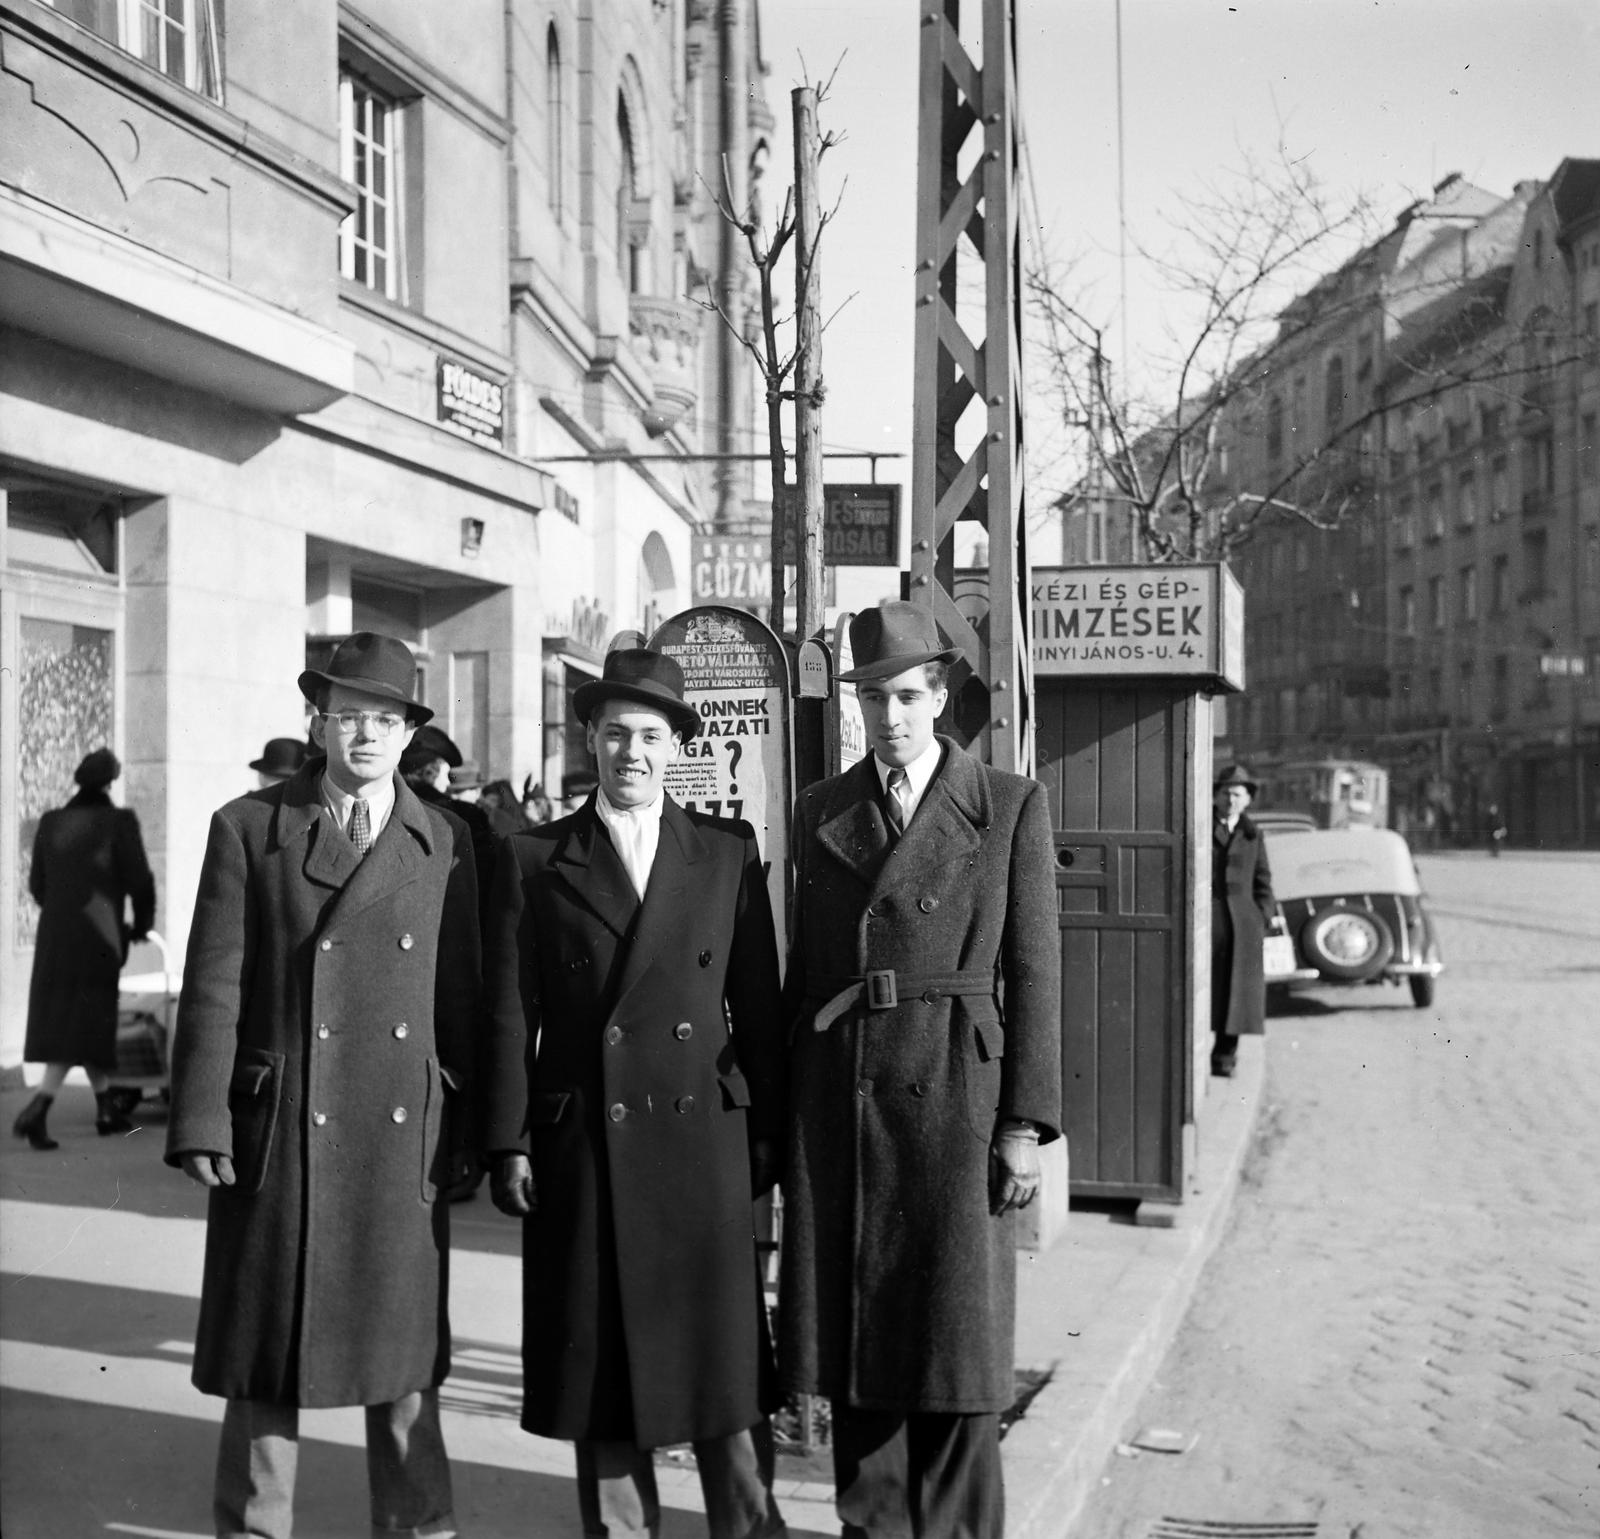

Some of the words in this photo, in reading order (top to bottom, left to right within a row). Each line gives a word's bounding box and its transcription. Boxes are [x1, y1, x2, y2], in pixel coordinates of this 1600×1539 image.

[1032, 579, 1087, 601] KÉZI
[1099, 577, 1127, 600] ÉS
[1138, 576, 1200, 599] GÉP-
[1032, 601, 1203, 640] IMZÉSEK
[661, 644, 701, 656] BUDAPEST
[1178, 641, 1203, 659] 4.
[714, 666, 770, 678] VÁROSHÁZA
[679, 740, 714, 758] GA
